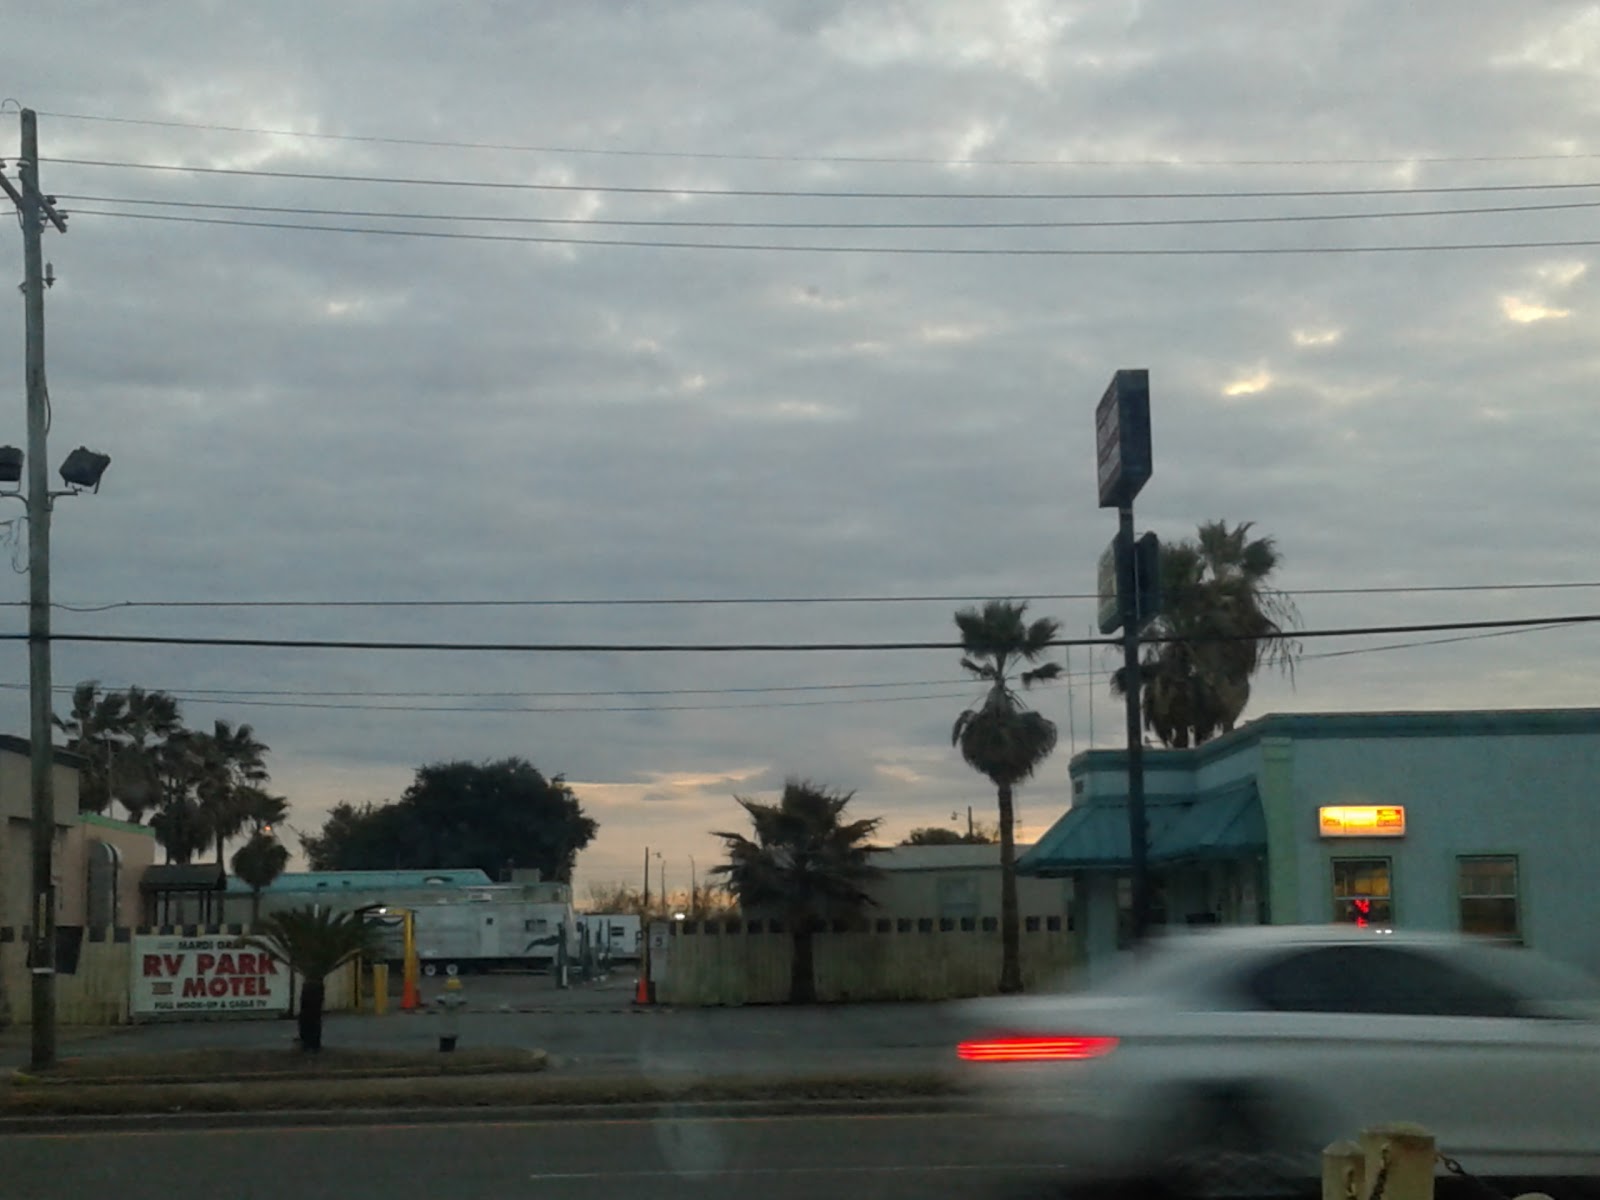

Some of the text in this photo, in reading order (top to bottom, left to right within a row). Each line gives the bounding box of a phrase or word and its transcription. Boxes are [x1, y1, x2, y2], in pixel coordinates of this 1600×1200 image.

[178, 941, 213, 950] MARDI
[143, 953, 278, 977] RV PARK
[182, 977, 272, 998] MOTEL
[256, 999, 267, 1007] TV
